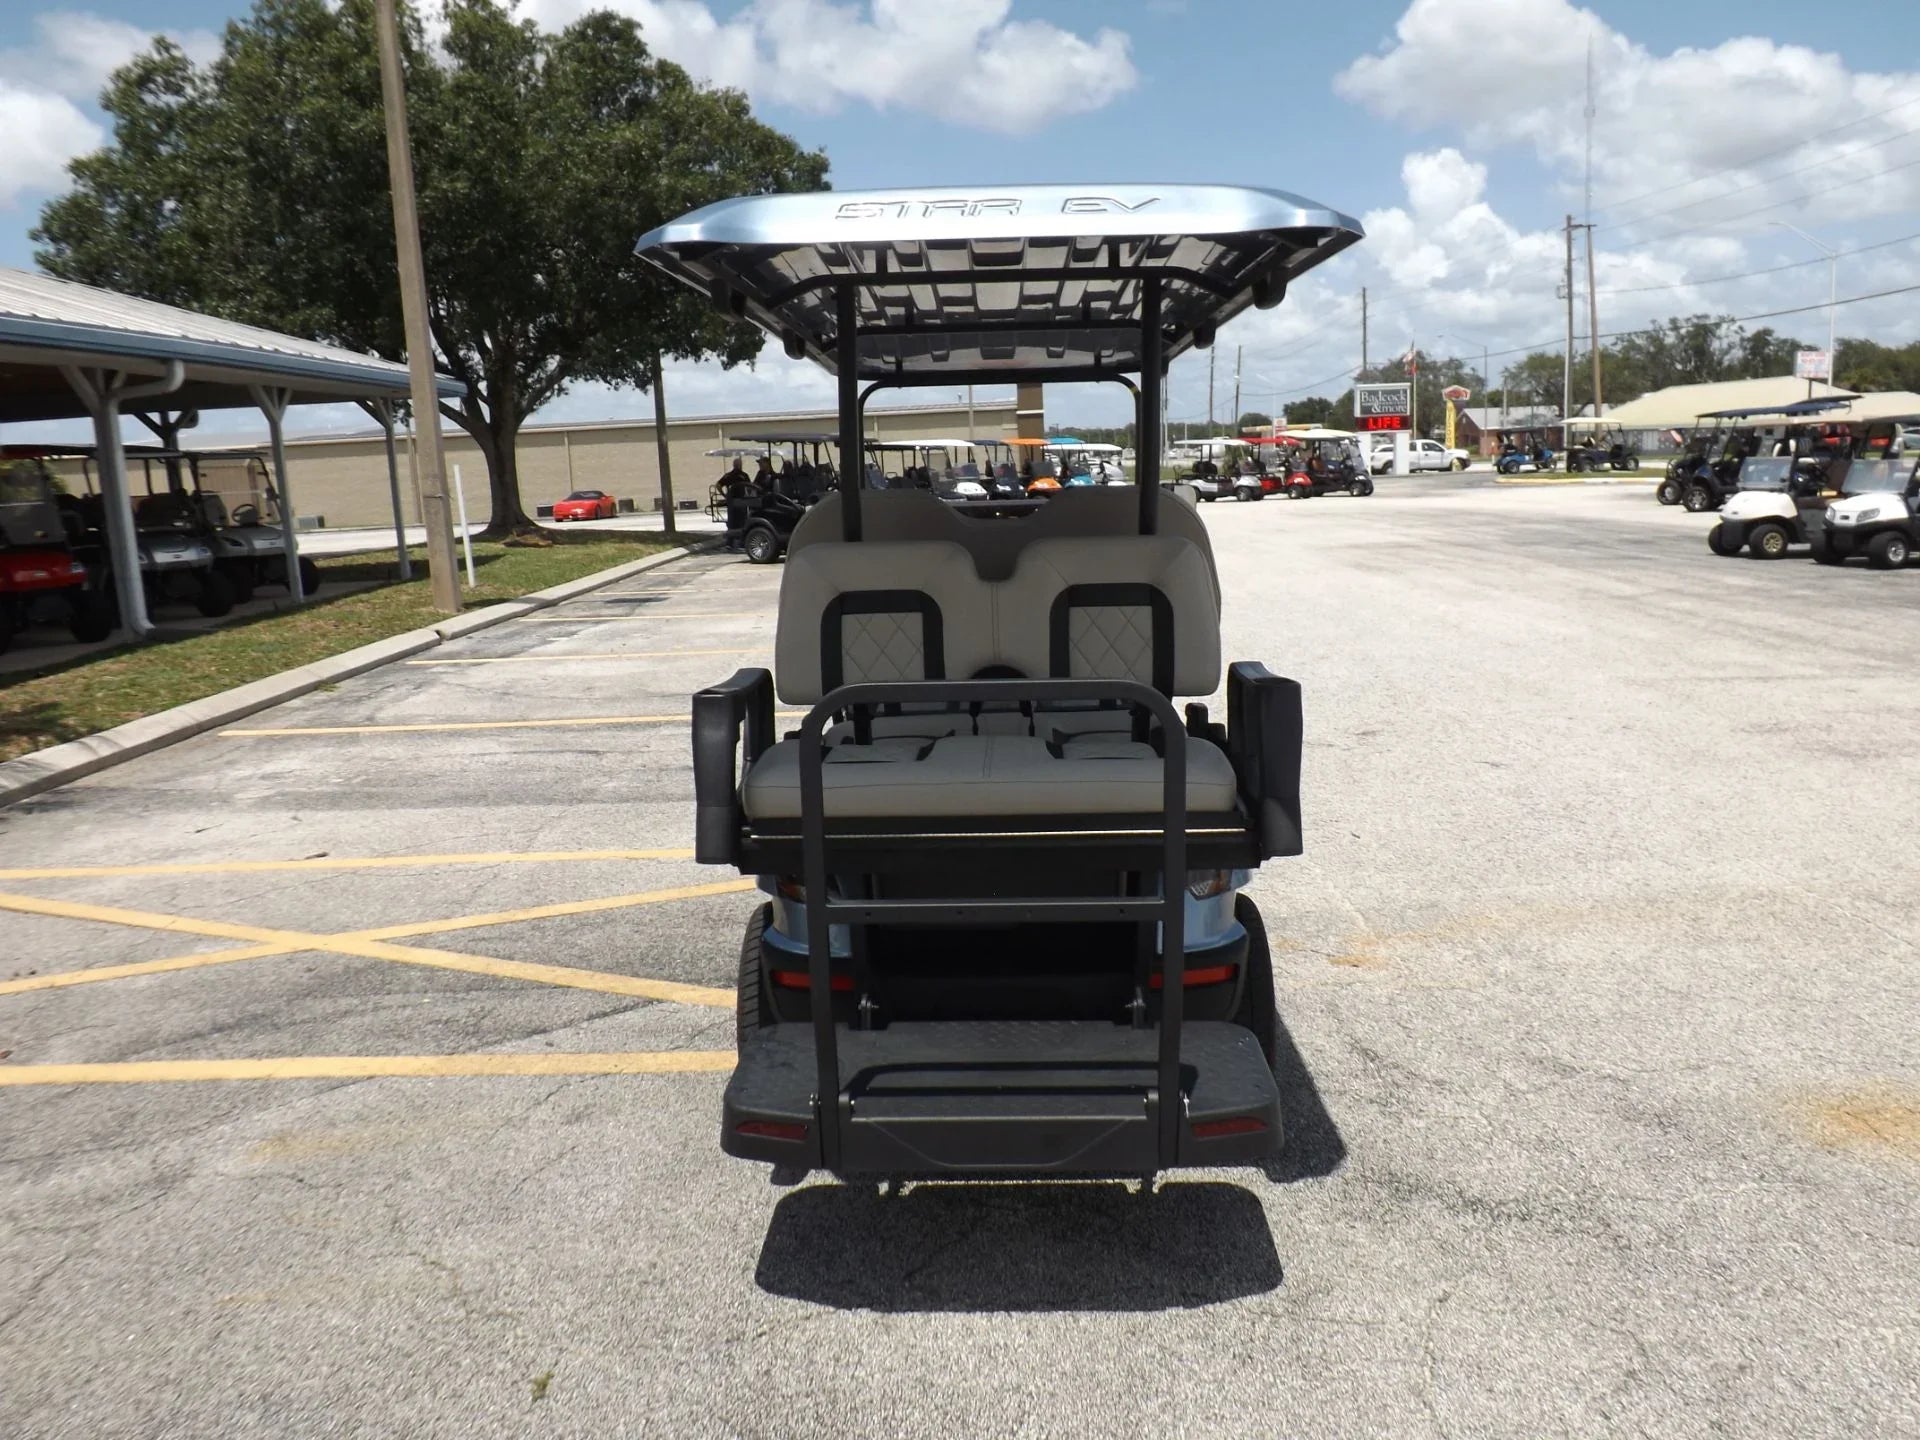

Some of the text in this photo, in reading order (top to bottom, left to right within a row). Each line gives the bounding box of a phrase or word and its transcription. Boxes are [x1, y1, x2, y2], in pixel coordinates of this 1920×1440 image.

[836, 197, 1160, 219] STAR EV
[1361, 389, 1406, 402] Badcock
[1367, 416, 1401, 430] LIFE
